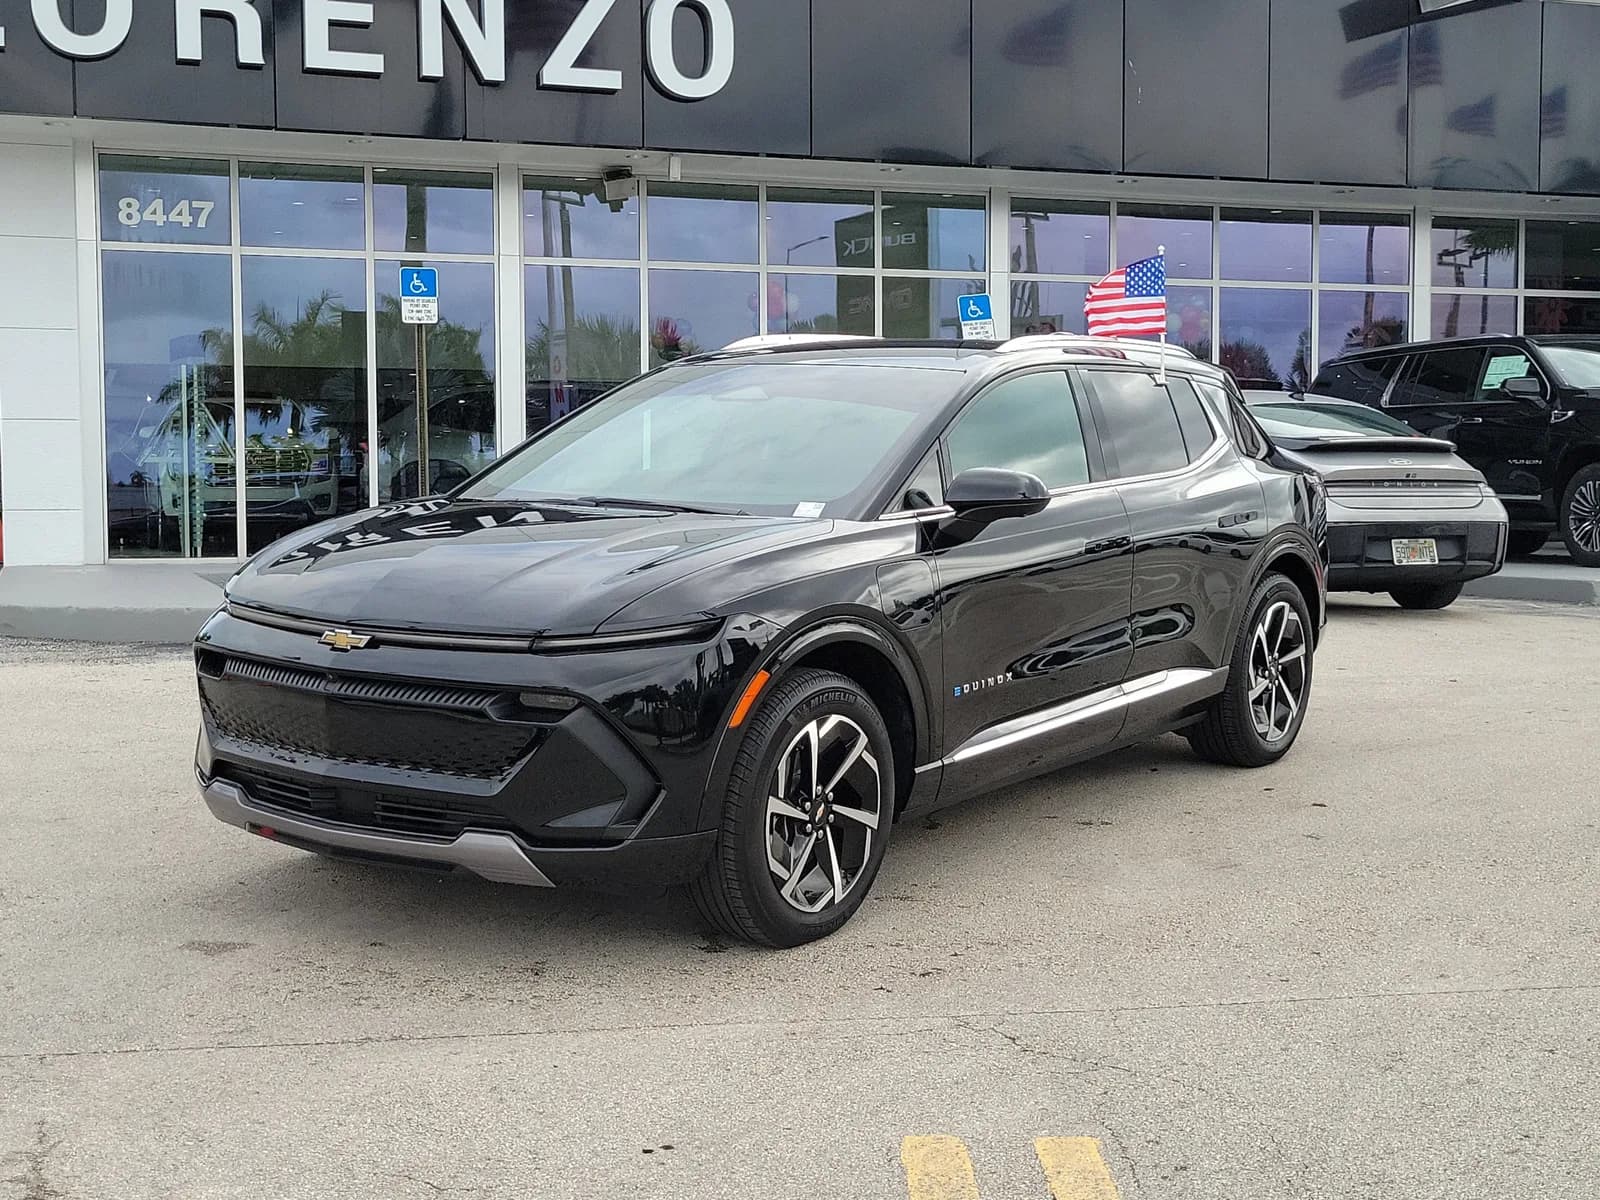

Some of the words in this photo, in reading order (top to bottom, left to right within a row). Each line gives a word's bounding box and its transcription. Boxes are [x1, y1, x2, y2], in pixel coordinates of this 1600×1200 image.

[0, 0, 735, 98] ORENZO
[118, 197, 215, 228] 8447
[954, 672, 1013, 697] EQUINOX
[811, 692, 857, 710] MICHELIN
